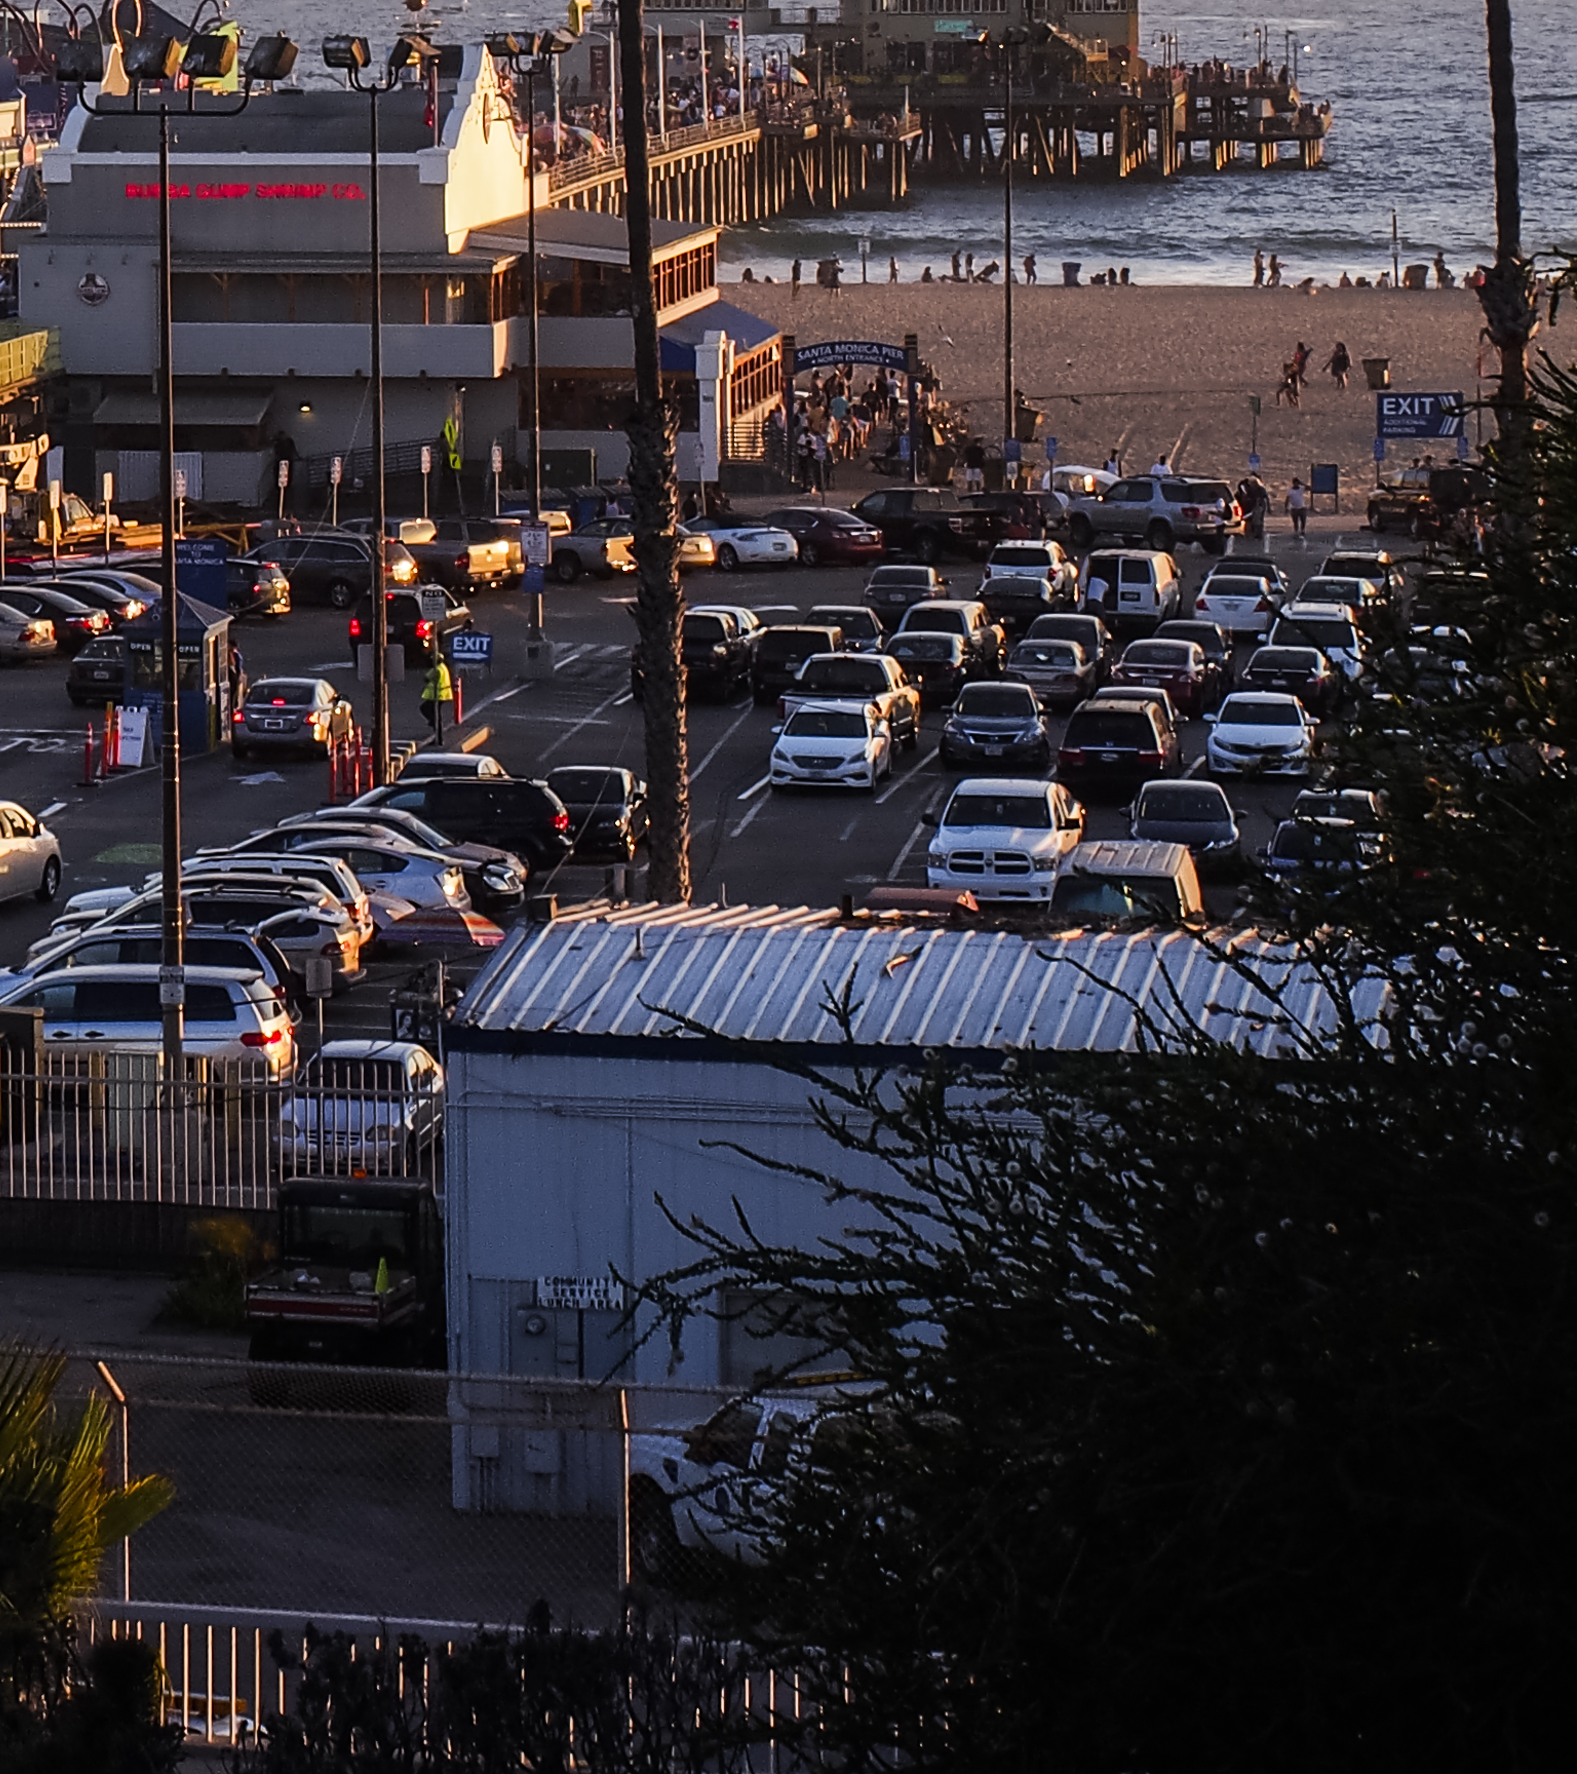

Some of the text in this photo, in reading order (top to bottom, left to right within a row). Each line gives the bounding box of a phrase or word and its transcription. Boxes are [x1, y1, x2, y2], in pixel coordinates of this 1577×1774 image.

[797, 344, 905, 362] SANTA MONICA PIER
[817, 354, 883, 364] NORTH ENTRANCE
[1382, 397, 1435, 415] EXIT
[130, 642, 151, 651] OPEN
[452, 636, 491, 651] EXIT
[552, 1287, 610, 1298] SERVICE
[589, 1299, 623, 1311] AREA
